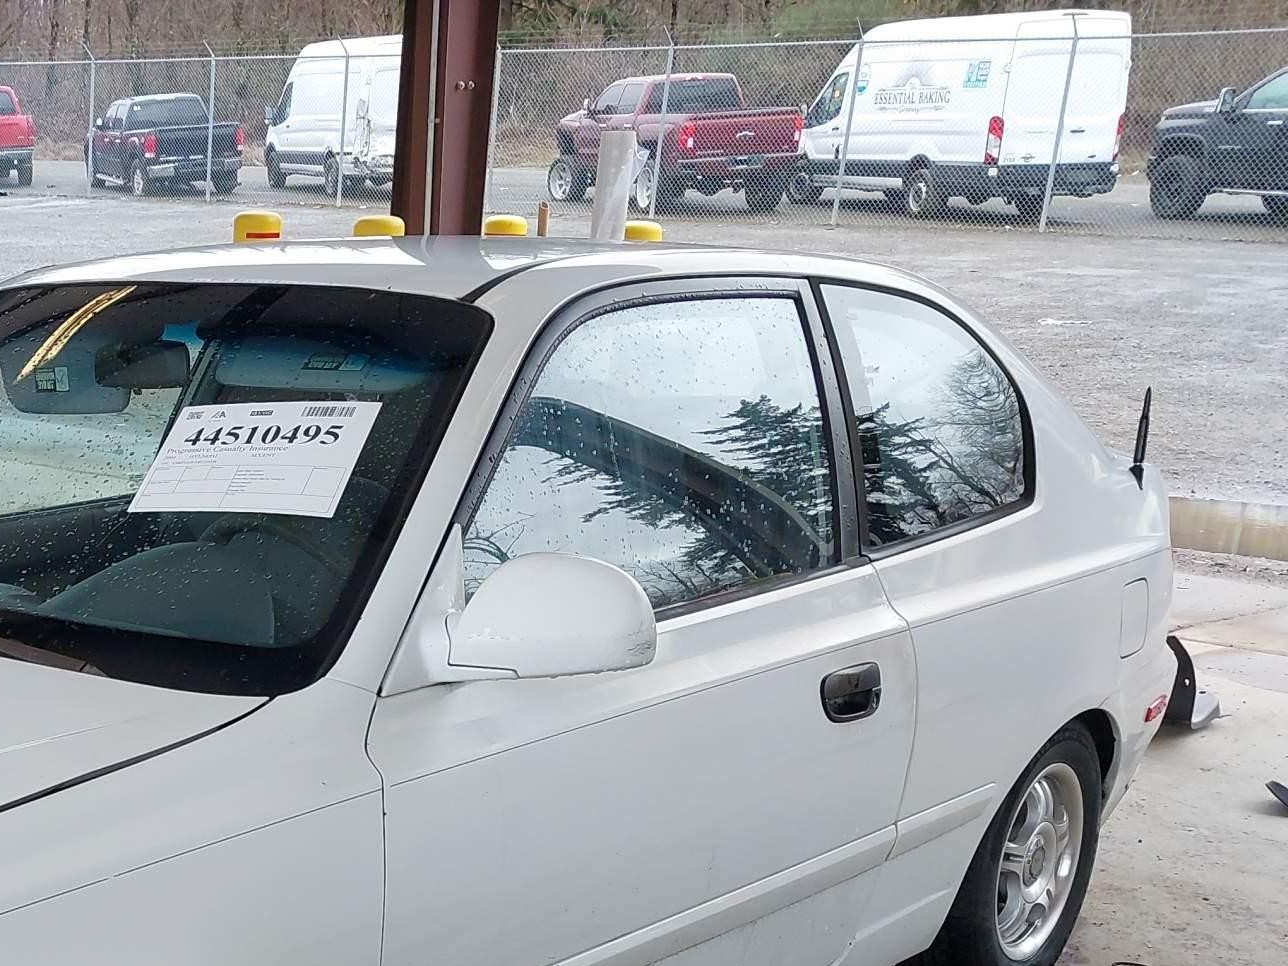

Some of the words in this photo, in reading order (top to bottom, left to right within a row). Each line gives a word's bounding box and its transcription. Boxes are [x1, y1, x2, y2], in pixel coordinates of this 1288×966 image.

[874, 91, 916, 105] ESSENTIAL
[918, 90, 951, 104] BAKING
[184, 424, 345, 446] 44510495
